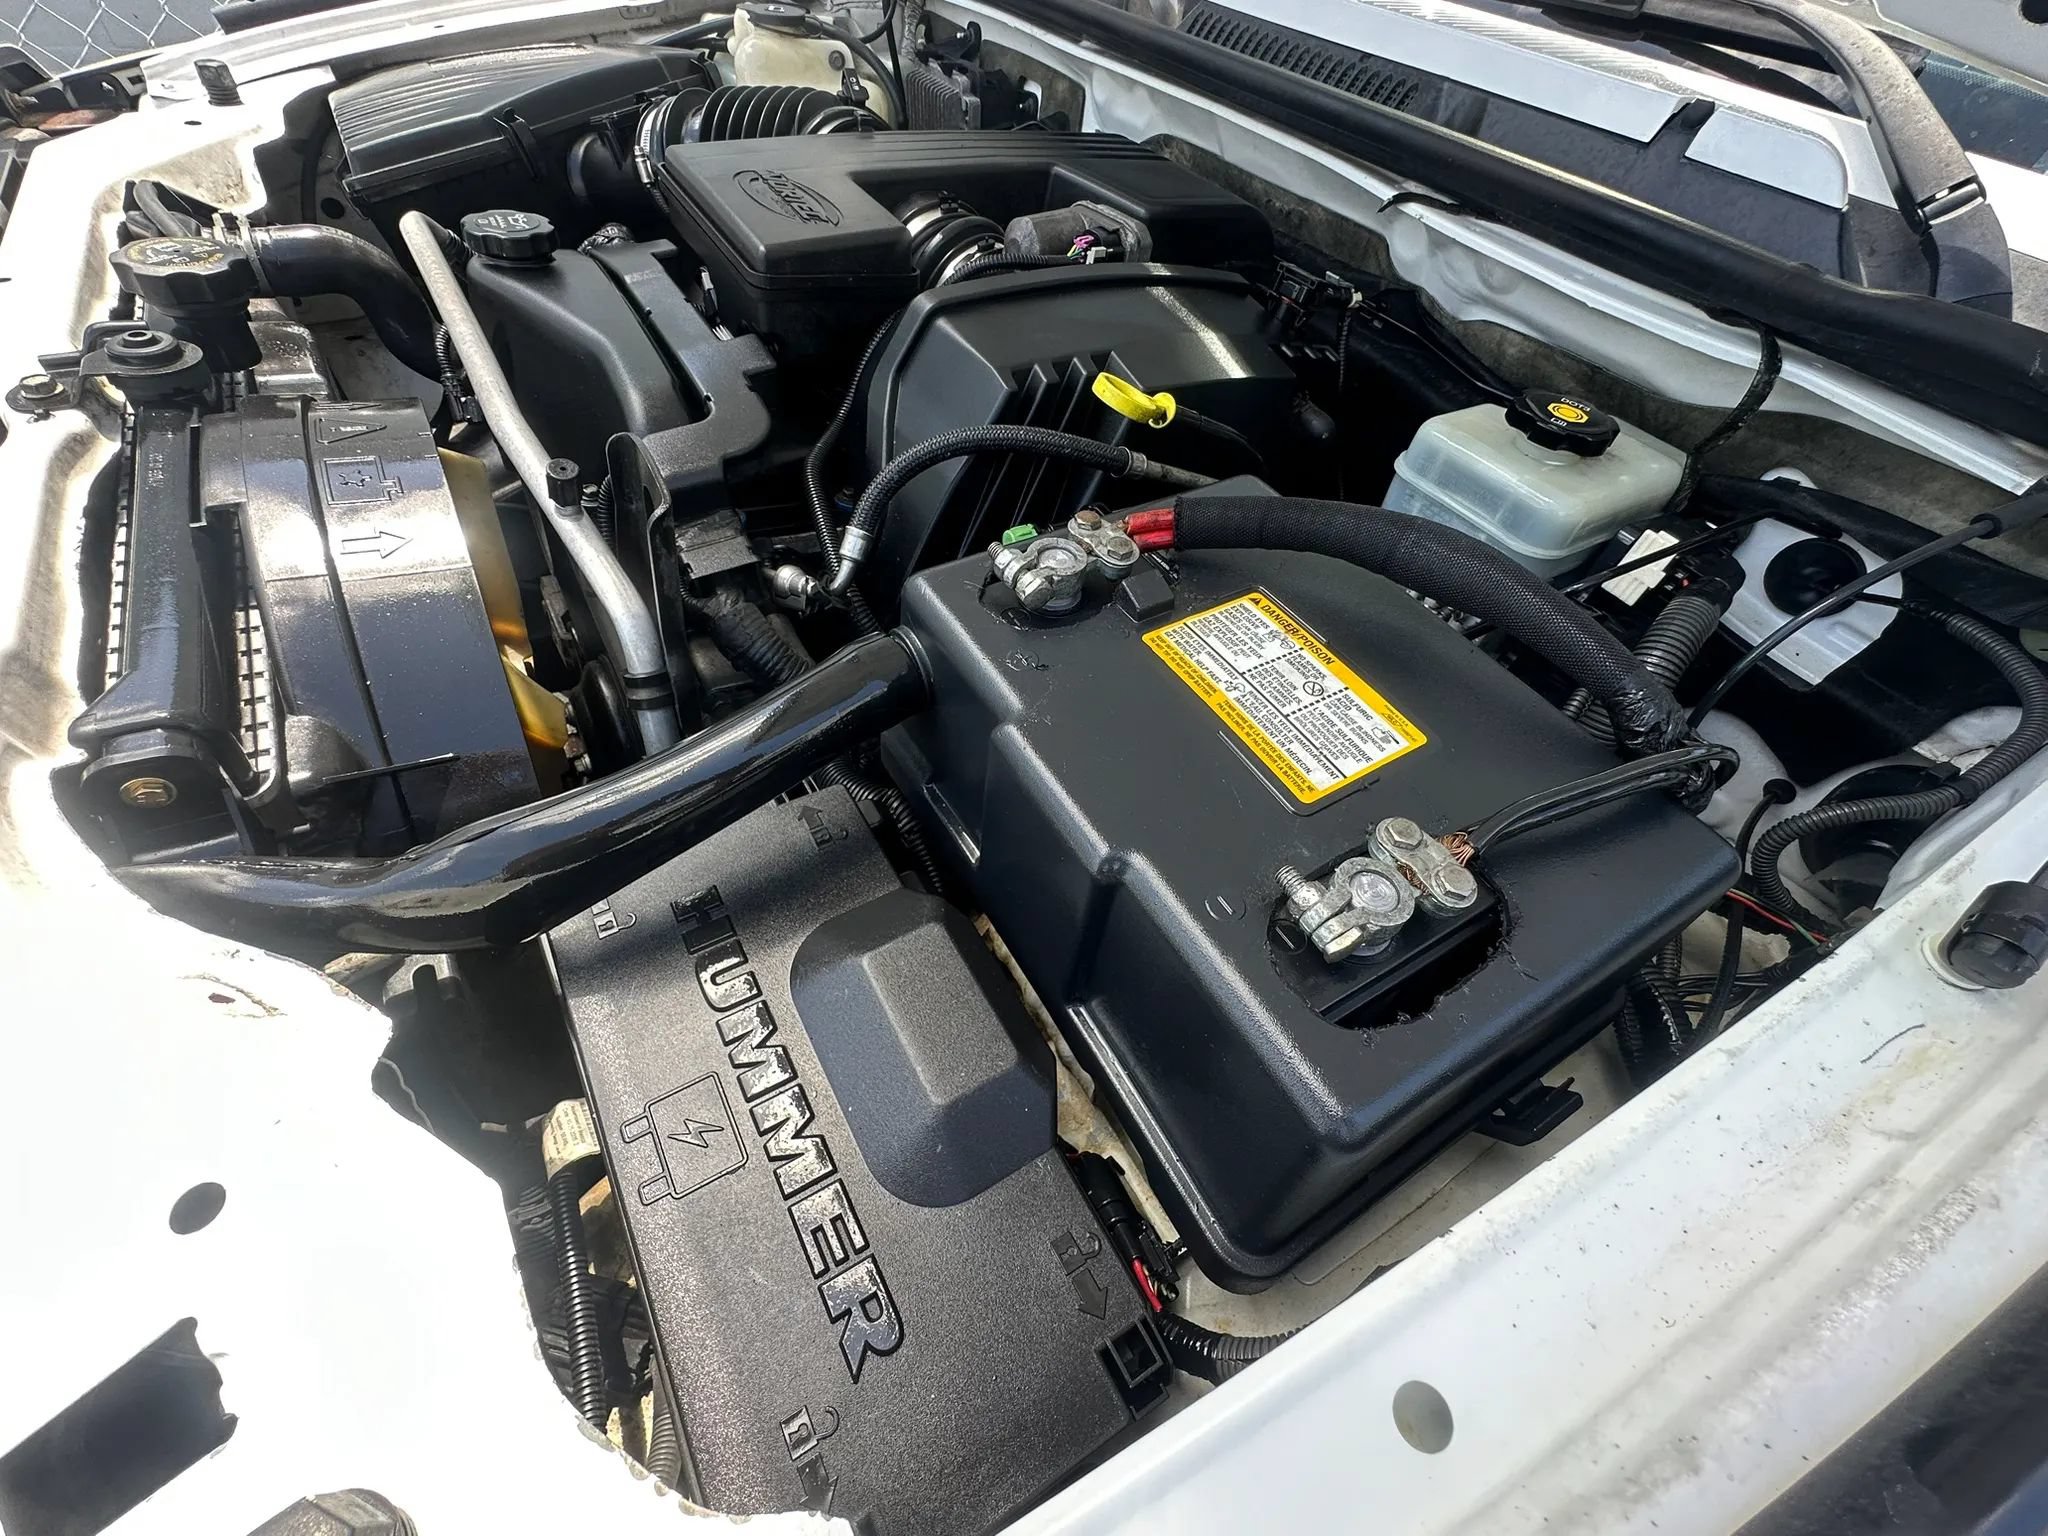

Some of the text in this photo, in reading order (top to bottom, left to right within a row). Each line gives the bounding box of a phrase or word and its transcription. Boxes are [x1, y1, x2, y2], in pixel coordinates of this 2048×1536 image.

[1561, 397, 1591, 411] DOT3
[1223, 608, 1266, 643] GASES CAN CAUSE
[1230, 605, 1260, 629] EXPLOSIVE
[1236, 603, 1270, 629] SHIELD EYES
[1171, 628, 1186, 639] WITH
[1201, 616, 1252, 658] GAZ EXPLOSIF PEUT
[1234, 636, 1249, 646] LES
[1245, 645, 1263, 659] YEUX
[1259, 604, 1335, 664] DANGER/POISON
[1164, 631, 1176, 640] GET
[1173, 639, 1196, 659] MEDICAL
[1193, 658, 1209, 671] HELP
[1177, 626, 1239, 680] FLUSH EYES IMMEDIATELY
[1254, 670, 1267, 680] DES
[1261, 667, 1274, 677] DES
[1267, 664, 1298, 691] TENIR LOIN
[1284, 657, 1311, 679] SMOKING
[1290, 655, 1320, 680] FLAMES OR
[1255, 680, 1269, 690] PAS
[1266, 689, 1287, 708] FUMER
[1334, 696, 1352, 711] ACID
[1340, 693, 1374, 721] SULFURIC
[1215, 702, 1226, 711] PAS
[1249, 737, 1262, 747] PAS
[1274, 763, 1284, 771] LA
[1246, 690, 1340, 780] RINCER LES YEUX IMMÉDIATEMENT
[1260, 714, 1294, 744] CONSULTER
[1299, 712, 1349, 759] OU PROVOQUER DES
[1305, 709, 1363, 763] PEUT RENDRE AVEUGLE
[1311, 706, 1338, 728] L'ACIDE
[1333, 727, 1374, 763] SULFURIQUE
[1322, 702, 1369, 744] OR SEVERE BURNS
[1328, 699, 1341, 710] CAN
[1338, 709, 1358, 725] CAUSE
[1355, 724, 1386, 752] BLINDNESS
[1275, 739, 1287, 748] UN
[1283, 747, 1315, 775] MÉDECIN.
[1317, 740, 1340, 760] GRAVES
[1274, 753, 1287, 763] DES
[1305, 784, 1315, 793] NE
[671, 884, 904, 1384] HUMMER
